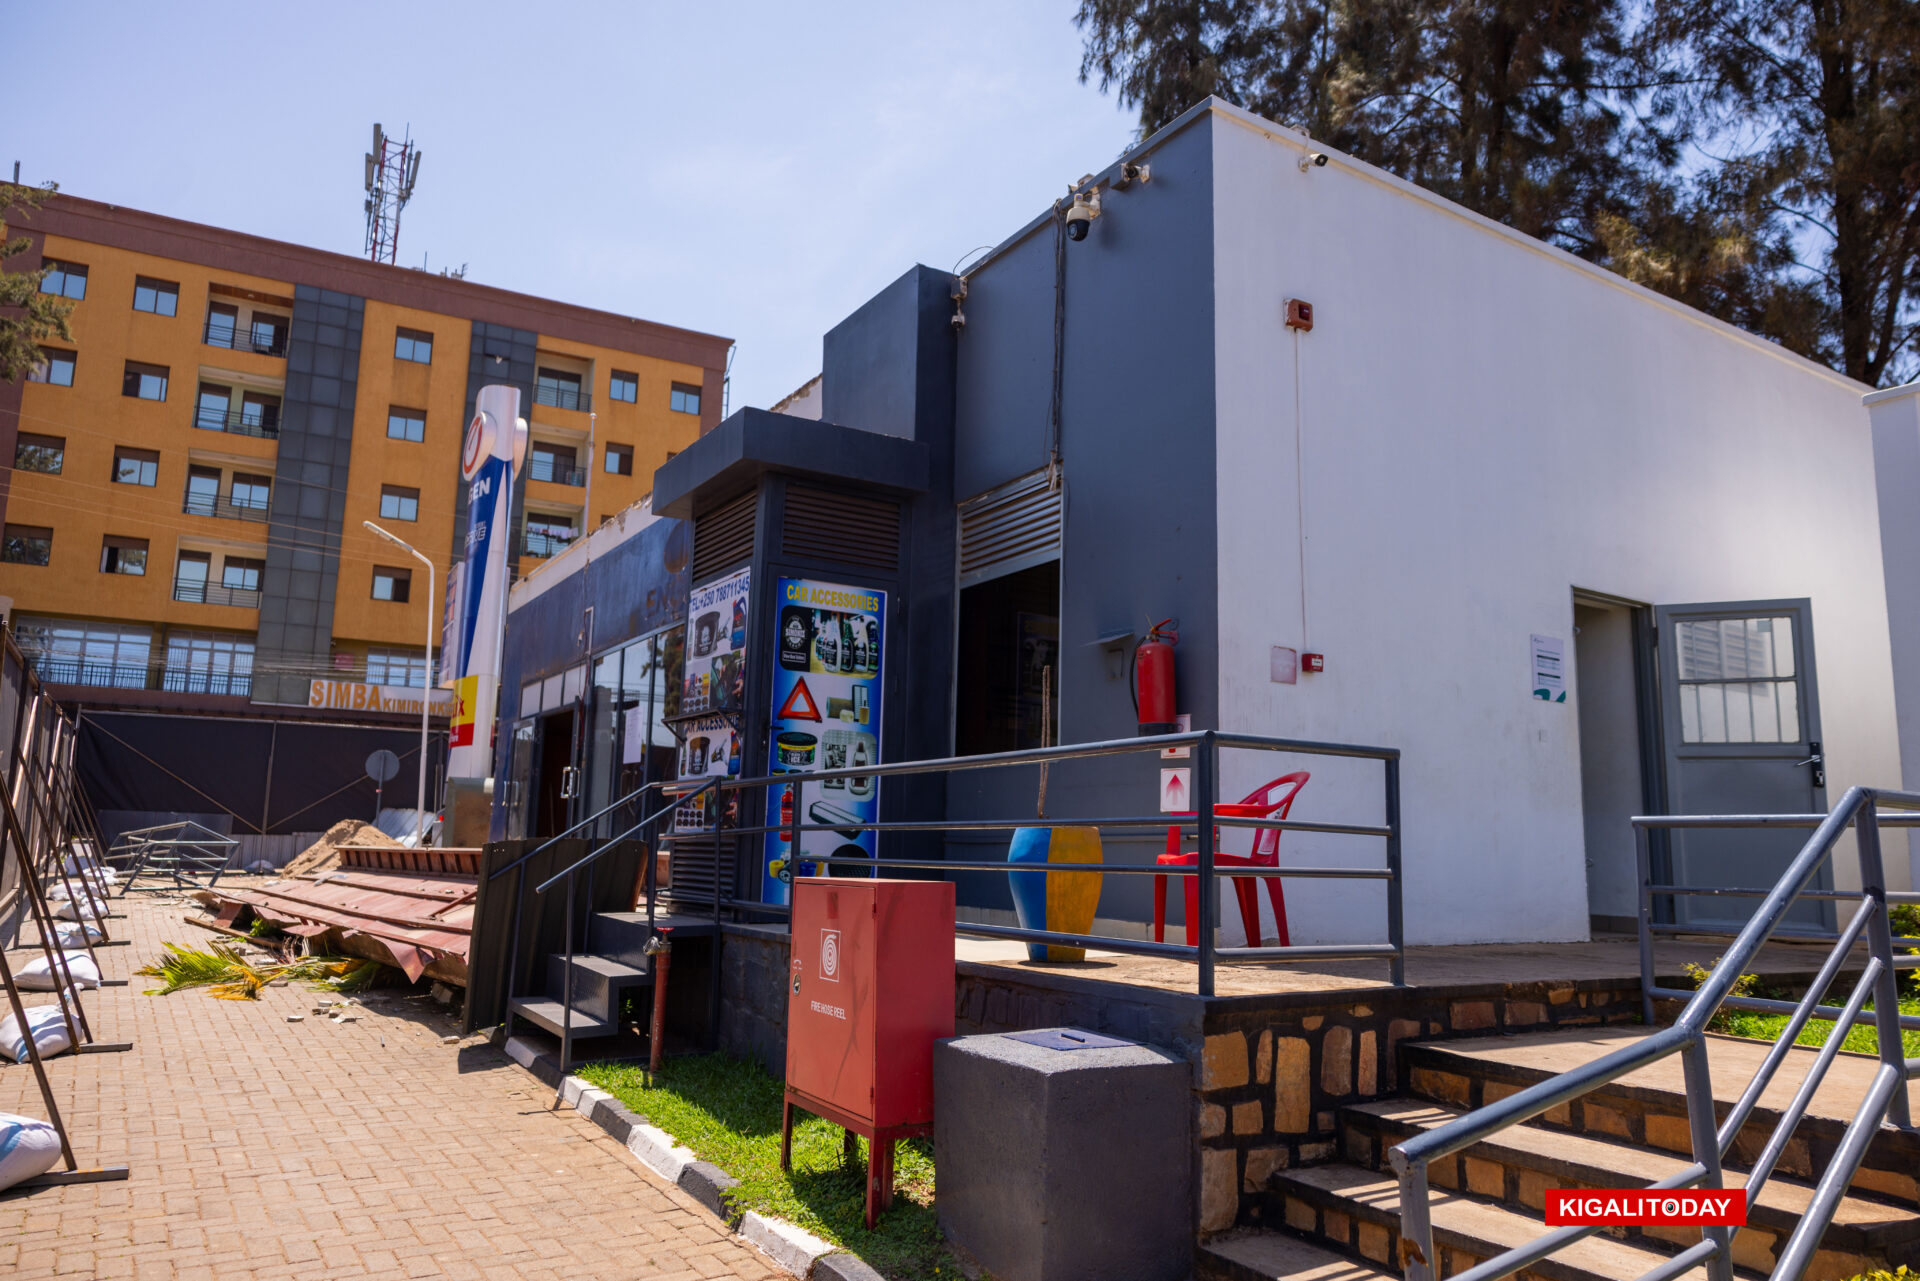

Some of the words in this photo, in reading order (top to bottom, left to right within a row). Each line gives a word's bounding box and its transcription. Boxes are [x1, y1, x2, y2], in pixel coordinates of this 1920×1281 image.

[715, 575, 750, 604] 788711345
[786, 584, 808, 603] CAR
[810, 588, 879, 612] ACCESSORIES
[311, 680, 381, 711] SIMBA
[810, 1000, 821, 1013] FIRE
[821, 1003, 834, 1017] HOSE
[834, 1006, 847, 1020] REEL
